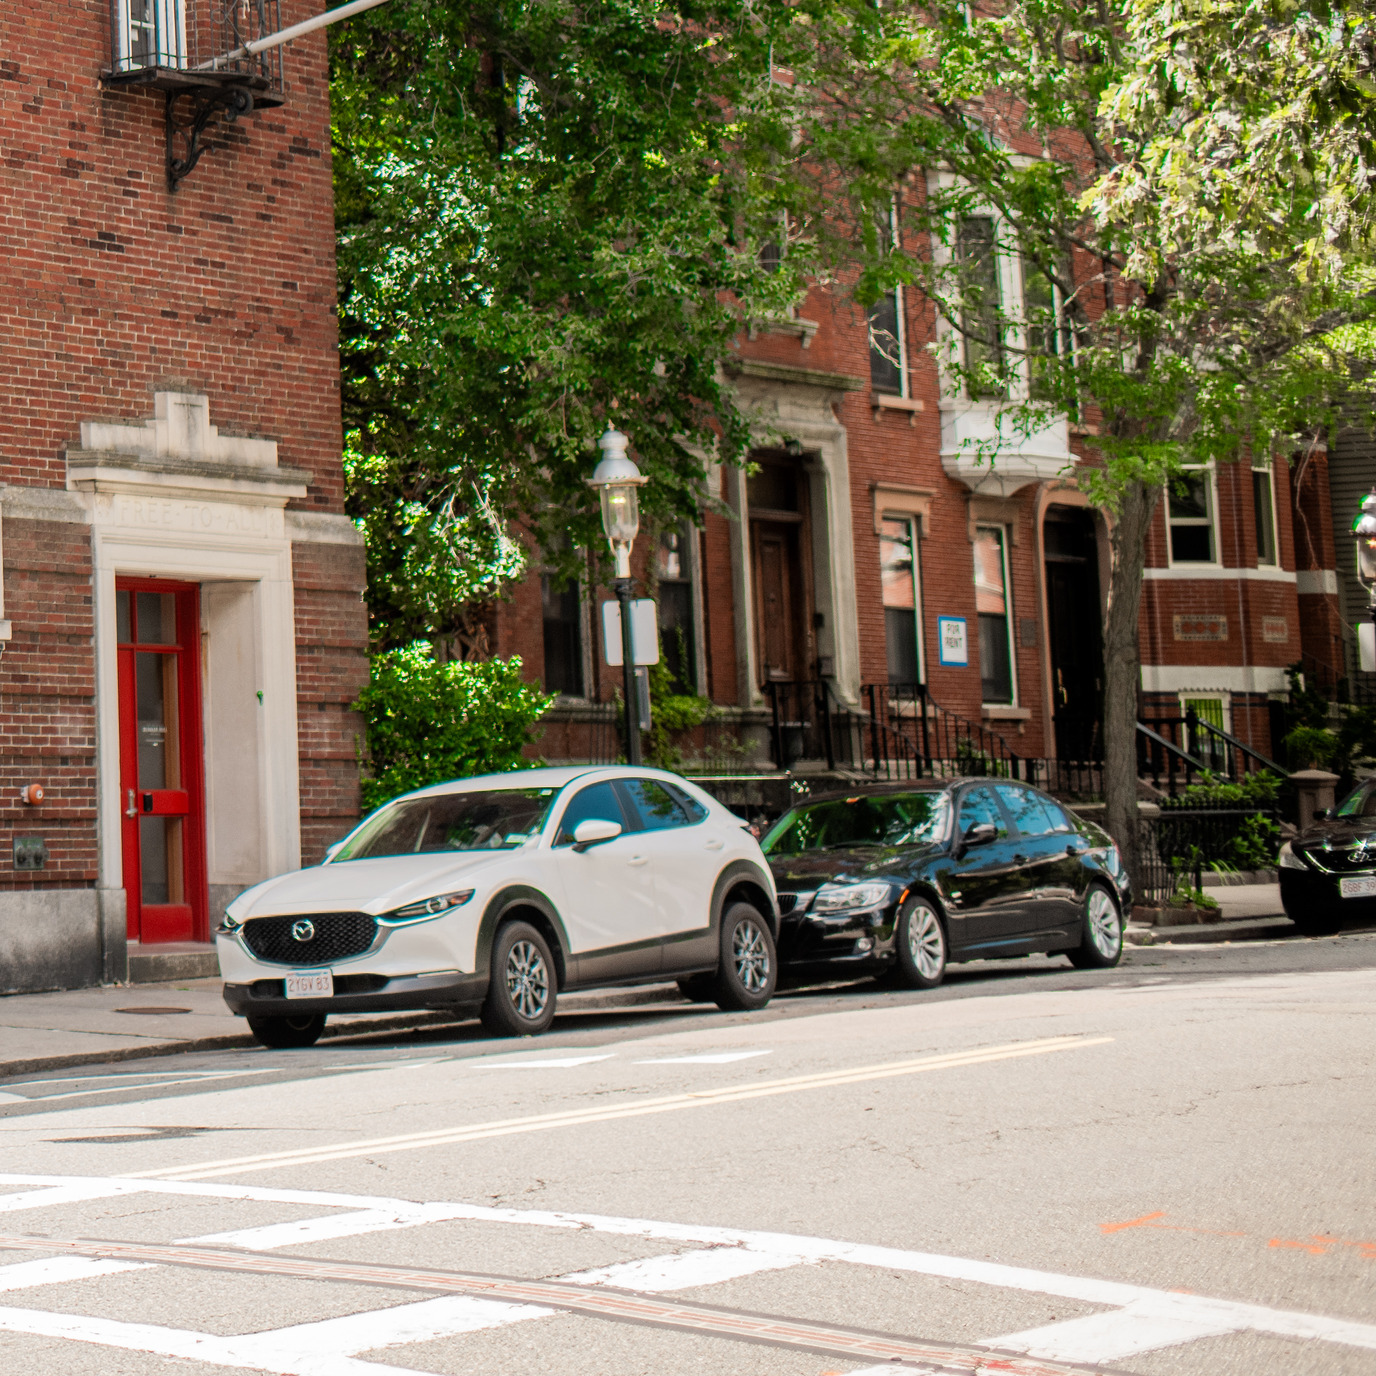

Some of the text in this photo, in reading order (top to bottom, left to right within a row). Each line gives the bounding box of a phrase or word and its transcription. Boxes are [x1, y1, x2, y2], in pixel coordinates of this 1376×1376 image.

[119, 499, 262, 532] FREE TO ALL
